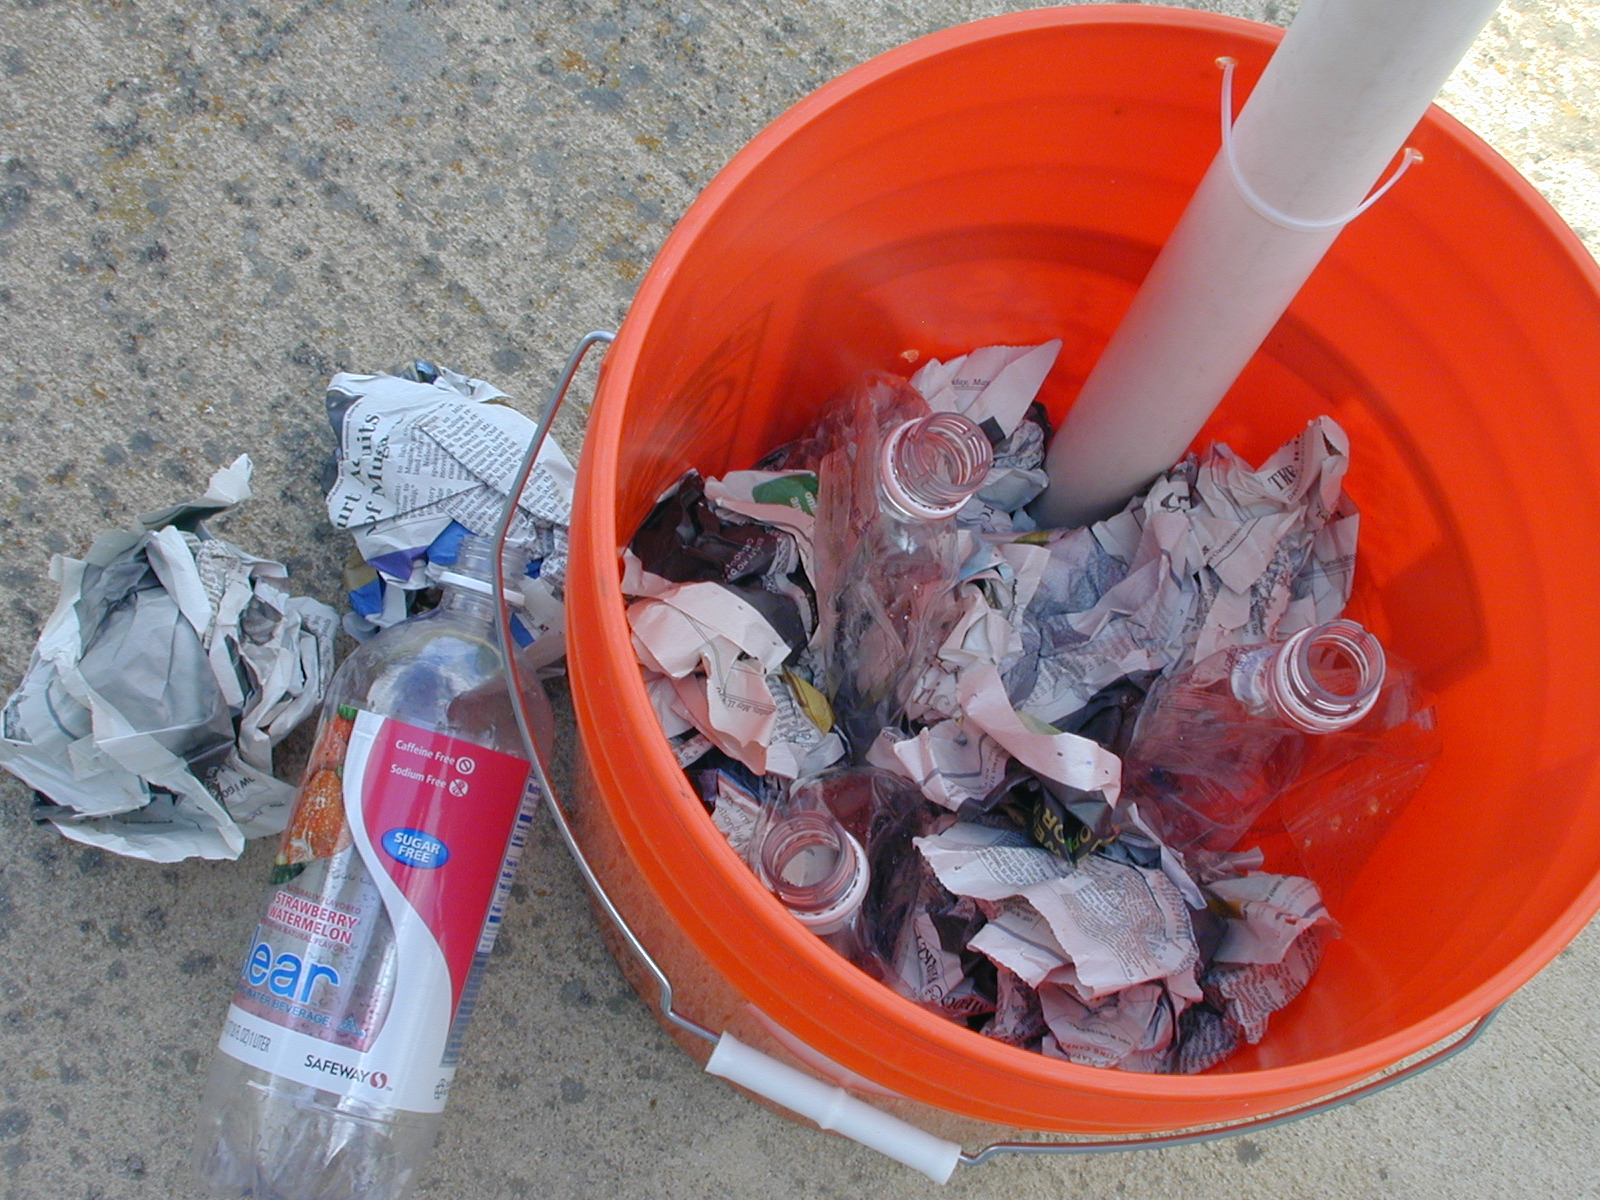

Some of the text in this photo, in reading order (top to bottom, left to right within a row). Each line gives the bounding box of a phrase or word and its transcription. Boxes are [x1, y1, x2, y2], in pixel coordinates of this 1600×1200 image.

[395, 739, 457, 766] Caffeine Free
[390, 764, 448, 790] Sodium Free
[393, 831, 442, 857] SUGAR
[396, 842, 433, 865] FREE
[274, 891, 357, 929] STRAWBERRY
[268, 905, 352, 944] WATERMELON
[270, 998, 330, 1026] BEVERAGE
[304, 1054, 370, 1083] SAFEWAY
